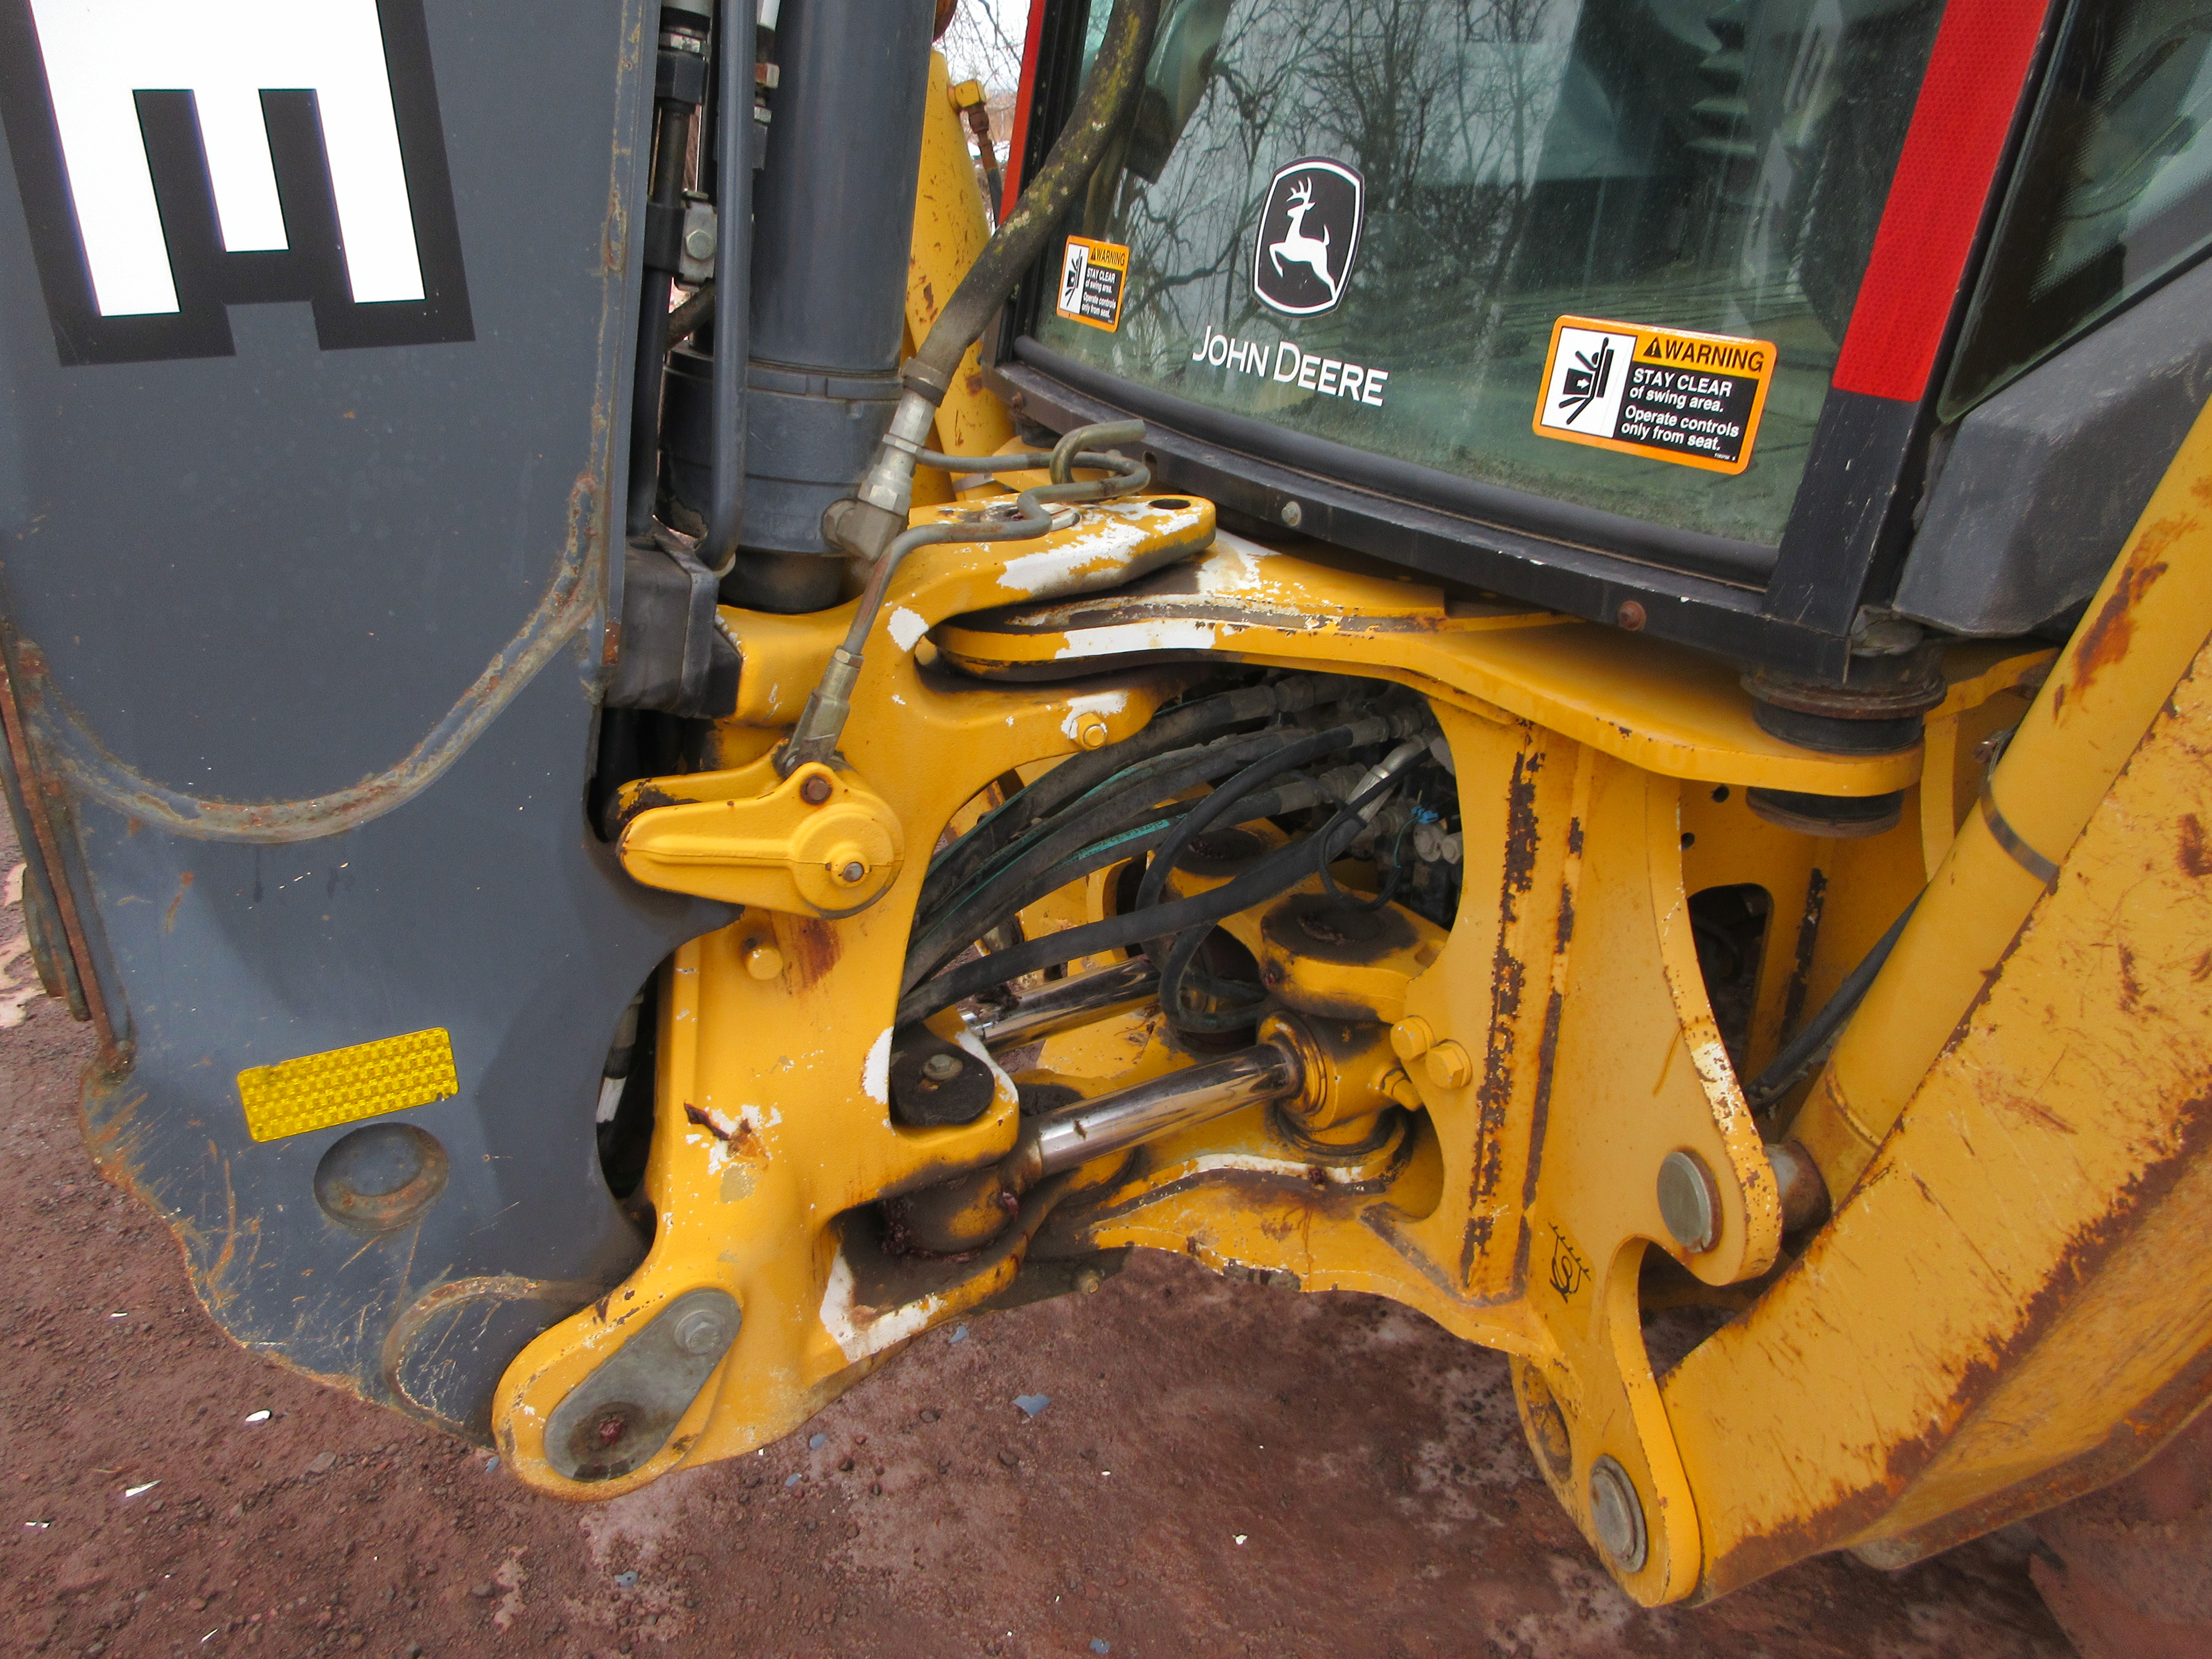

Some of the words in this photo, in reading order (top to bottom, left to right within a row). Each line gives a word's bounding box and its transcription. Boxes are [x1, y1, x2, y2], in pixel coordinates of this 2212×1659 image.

[1097, 248, 1125, 266] WARNING
[1085, 279, 1090, 288] of
[1090, 280, 1102, 293] swing
[1102, 284, 1112, 294] area.
[1086, 267, 1099, 279] STAY
[1099, 270, 1116, 283] CLEAR
[1082, 303, 1091, 314] only
[1090, 304, 1100, 315] from
[1100, 309, 1110, 318] seat.
[1083, 291, 1099, 304] Operate
[1098, 297, 1116, 309] controls
[1192, 325, 1270, 377] JOHN
[1272, 341, 1389, 407] DEERE
[1665, 339, 1764, 372] WARNING
[1633, 368, 1675, 387] STAY
[1677, 375, 1733, 397] CLEAR
[1629, 385, 1644, 399] of
[1646, 389, 1687, 409] swing
[1689, 396, 1724, 413] area.
[1625, 405, 1677, 426] Operate
[1680, 418, 1740, 437] controls
[1621, 423, 1650, 440] only
[1652, 426, 1684, 444] from
[1687, 435, 1720, 451] seat.
